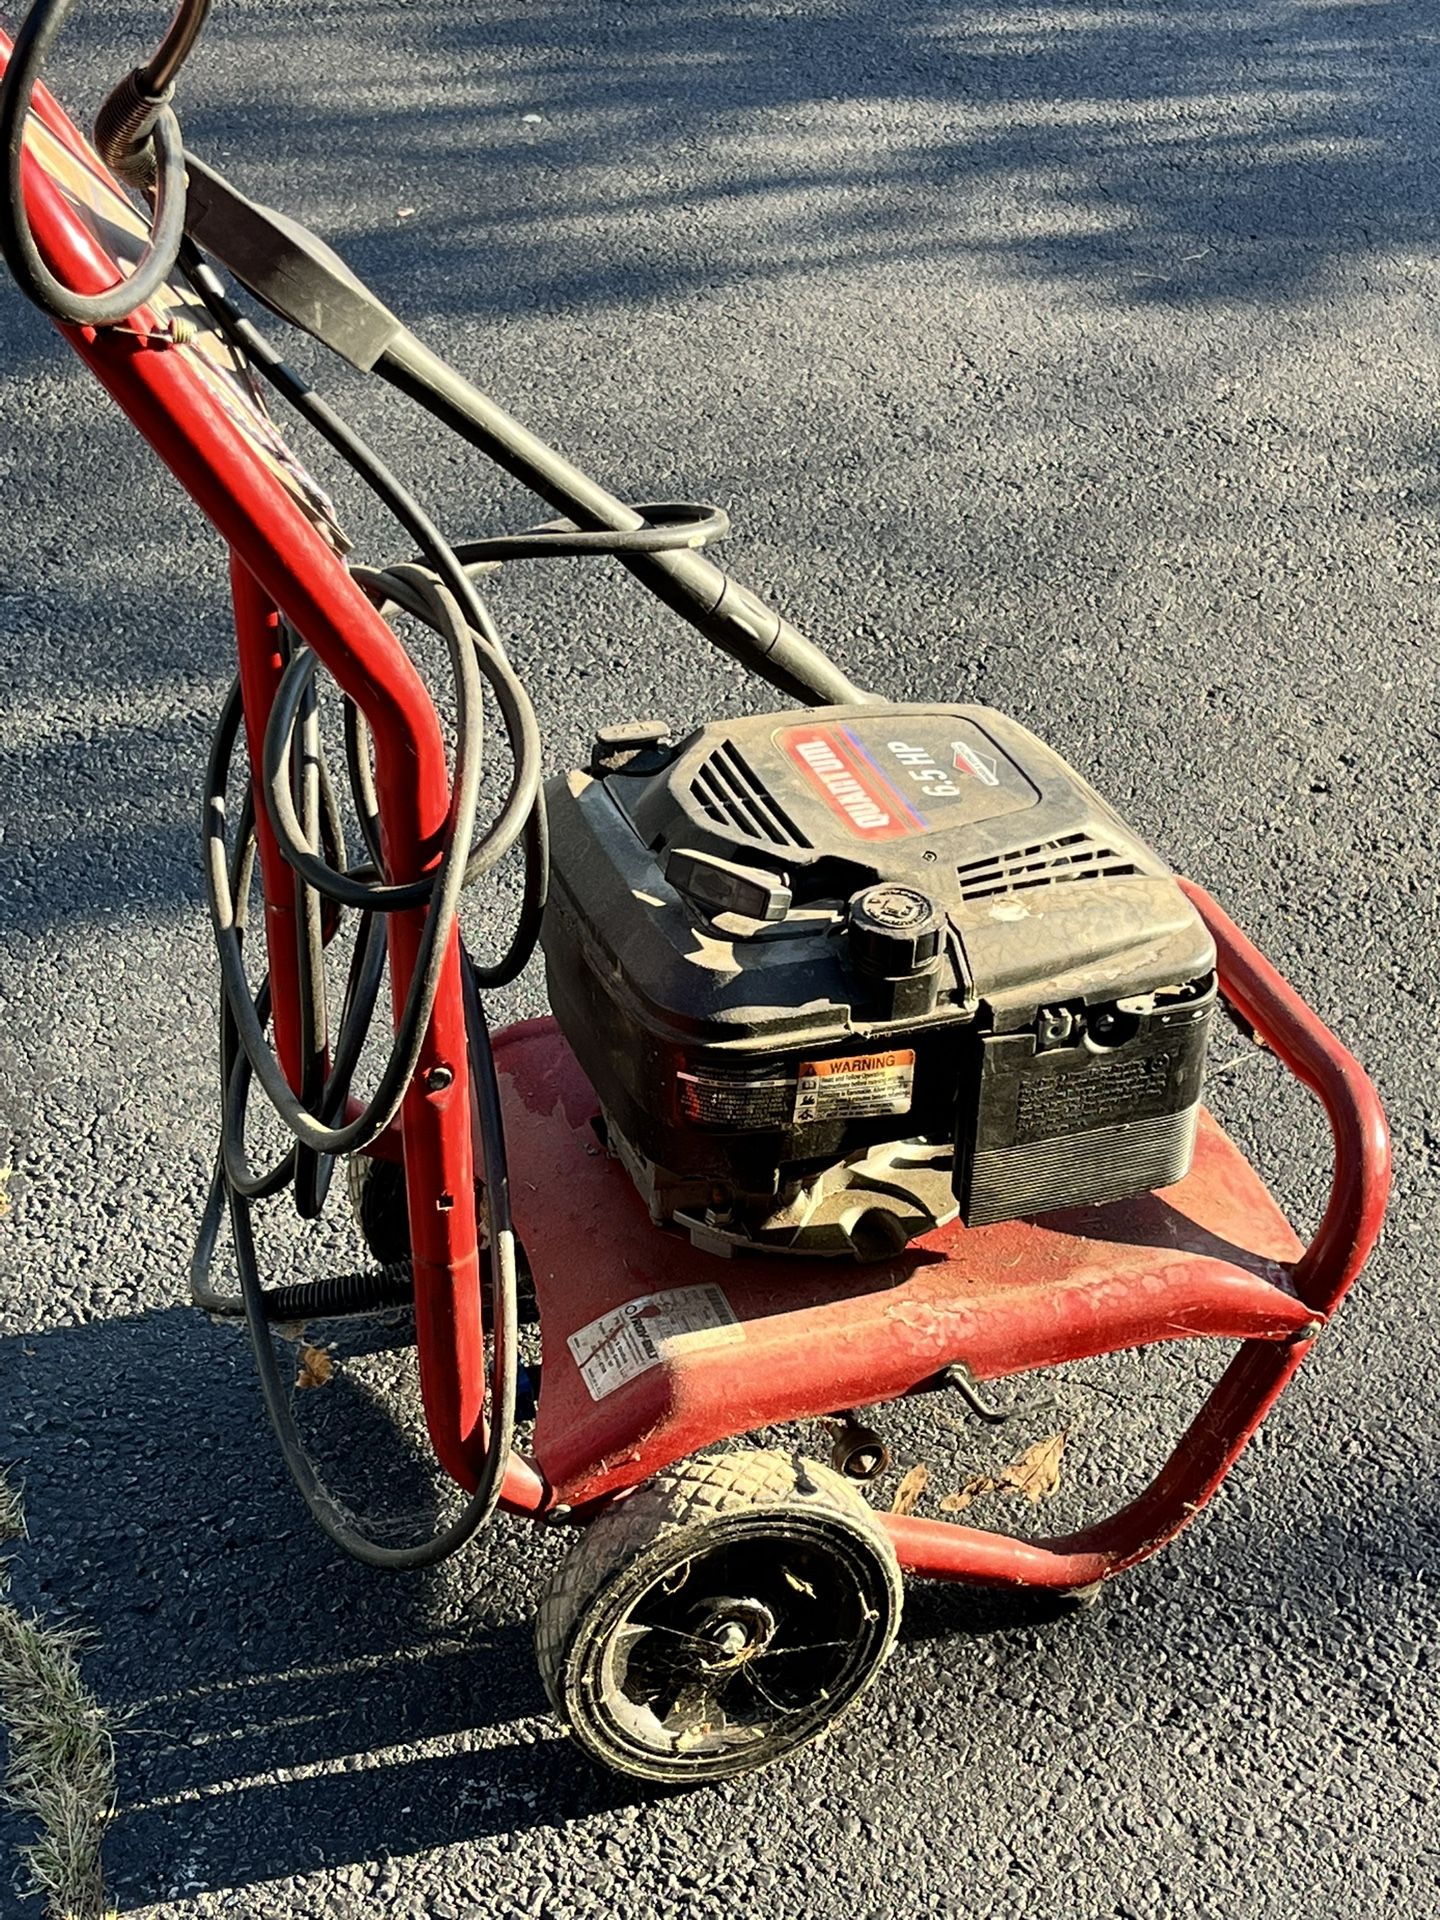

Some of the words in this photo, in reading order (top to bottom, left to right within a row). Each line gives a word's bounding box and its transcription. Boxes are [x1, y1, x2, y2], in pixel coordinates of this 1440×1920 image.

[887, 741, 936, 766] HP
[795, 739, 890, 829] QUANTUM
[908, 768, 961, 797] 6.5
[829, 1054, 896, 1075] WARNING
